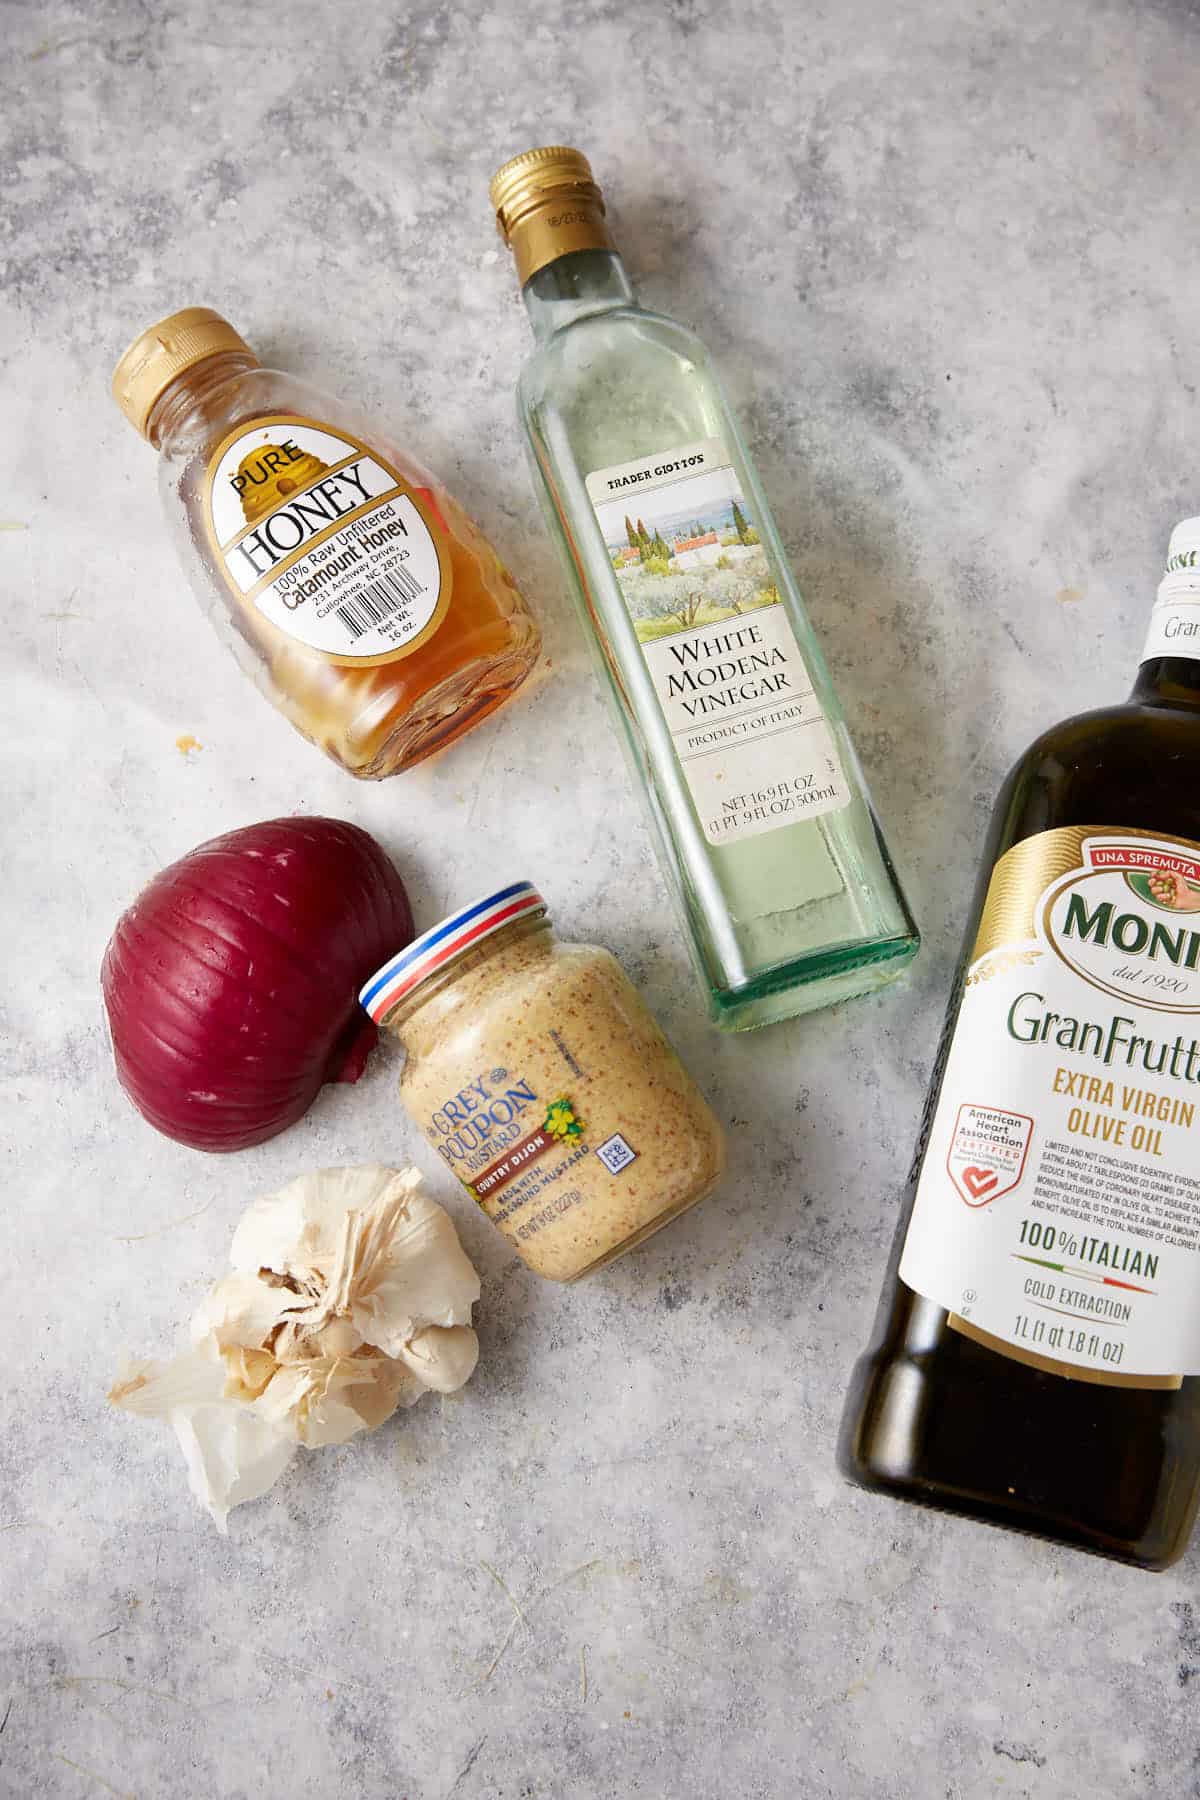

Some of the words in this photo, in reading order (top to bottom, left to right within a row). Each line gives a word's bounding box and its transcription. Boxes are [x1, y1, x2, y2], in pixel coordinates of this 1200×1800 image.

[230, 439, 304, 499] PURE
[608, 470, 652, 489] TRADER
[655, 455, 704, 476] GIOTTO'S
[236, 464, 373, 577] HONEY
[273, 565, 309, 596] 100%
[308, 543, 336, 569] Raw
[338, 505, 395, 546] Unfiltered
[281, 545, 363, 611] Catamount
[357, 519, 408, 554] Honey
[312, 590, 329, 606] 231
[332, 562, 369, 593] Archway
[370, 545, 399, 565] Drive,
[316, 583, 366, 619] Cullowhee,
[366, 567, 380, 581] NC
[380, 551, 410, 571] 28723
[377, 619, 396, 636] Net
[397, 609, 413, 624] Wt.
[389, 629, 401, 641] 16
[402, 623, 417, 634] oz.
[670, 625, 763, 666] WHITE
[668, 648, 788, 697] MODENA
[681, 673, 791, 717] VINEGAR
[688, 722, 748, 748] PRODUCT
[751, 715, 768, 730] OF
[768, 705, 803, 722] ITALY
[722, 795, 747, 813] NET
[751, 784, 776, 803] 16.9
[778, 778, 794, 796] FL
[794, 774, 816, 791] OZ
[722, 812, 738, 830] PT
[754, 805, 769, 820] FL
[1096, 852, 1125, 863] UNA
[1129, 852, 1196, 875] SPREMUTA
[1062, 893, 1200, 970] MONI
[1112, 966, 1142, 981] dal
[1141, 971, 1189, 994] 1920
[1008, 992, 1200, 1084] GranFrutt
[432, 1076, 492, 1135] GREY
[969, 1109, 1022, 1128] American
[1053, 1067, 1114, 1107] EXTRA
[1122, 1086, 1195, 1128] VIRGIN
[438, 1079, 537, 1168] POUPON
[960, 1128, 1023, 1148] Association
[976, 1120, 1009, 1134] Heart
[1067, 1107, 1127, 1145] OLIVE
[1131, 1125, 1163, 1156] OIL
[466, 1123, 521, 1172] MUSTARD
[476, 1162, 511, 1194] COUNTRY
[511, 1135, 545, 1166] DIJON
[542, 1145, 590, 1185] MUSTARD
[1045, 1140, 1070, 1153] LIMITED
[1070, 1146, 1083, 1156] AND
[1084, 1150, 1098, 1161] NOT
[1099, 1154, 1138, 1172] CONCLUSIVE
[1140, 1164, 1173, 1181] SCIENTIFIC
[1040, 1163, 1065, 1177] REDUCE
[1067, 1170, 1078, 1180] THE
[1079, 1174, 1093, 1185] RISK
[1095, 1178, 1105, 1187] OF
[1105, 1181, 1141, 1198] CORONARY
[1141, 1191, 1163, 1204] HEART
[1042, 1152, 1065, 1164] EATING
[1066, 1159, 1087, 1170] ABOUT
[1094, 1166, 1138, 1184] TABLESPOONS
[1175, 1188, 1185, 1197] OF
[1062, 1195, 1081, 1206] OLIVE
[1110, 1208, 1139, 1223] REPLACE
[1101, 1193, 1113, 1203] FAT
[1121, 1198, 1140, 1210] OLIVE
[1031, 1200, 1044, 1209] AND
[1045, 1204, 1059, 1214] NOT
[1060, 1208, 1091, 1222] INCREASE
[1092, 1216, 1105, 1226] THE
[1106, 1219, 1126, 1231] TOTAL
[1155, 1232, 1164, 1240] OF
[1165, 1234, 1197, 1249] CALORIES
[1019, 1219, 1077, 1256] 100%
[1079, 1236, 1159, 1279] ITALIAN
[1024, 1278, 1055, 1301] COLD
[1058, 1288, 1132, 1321] EXTRACTION
[1049, 1326, 1063, 1348] qt
[1068, 1330, 1086, 1352] 1.8
[1088, 1335, 1100, 1357] fl
